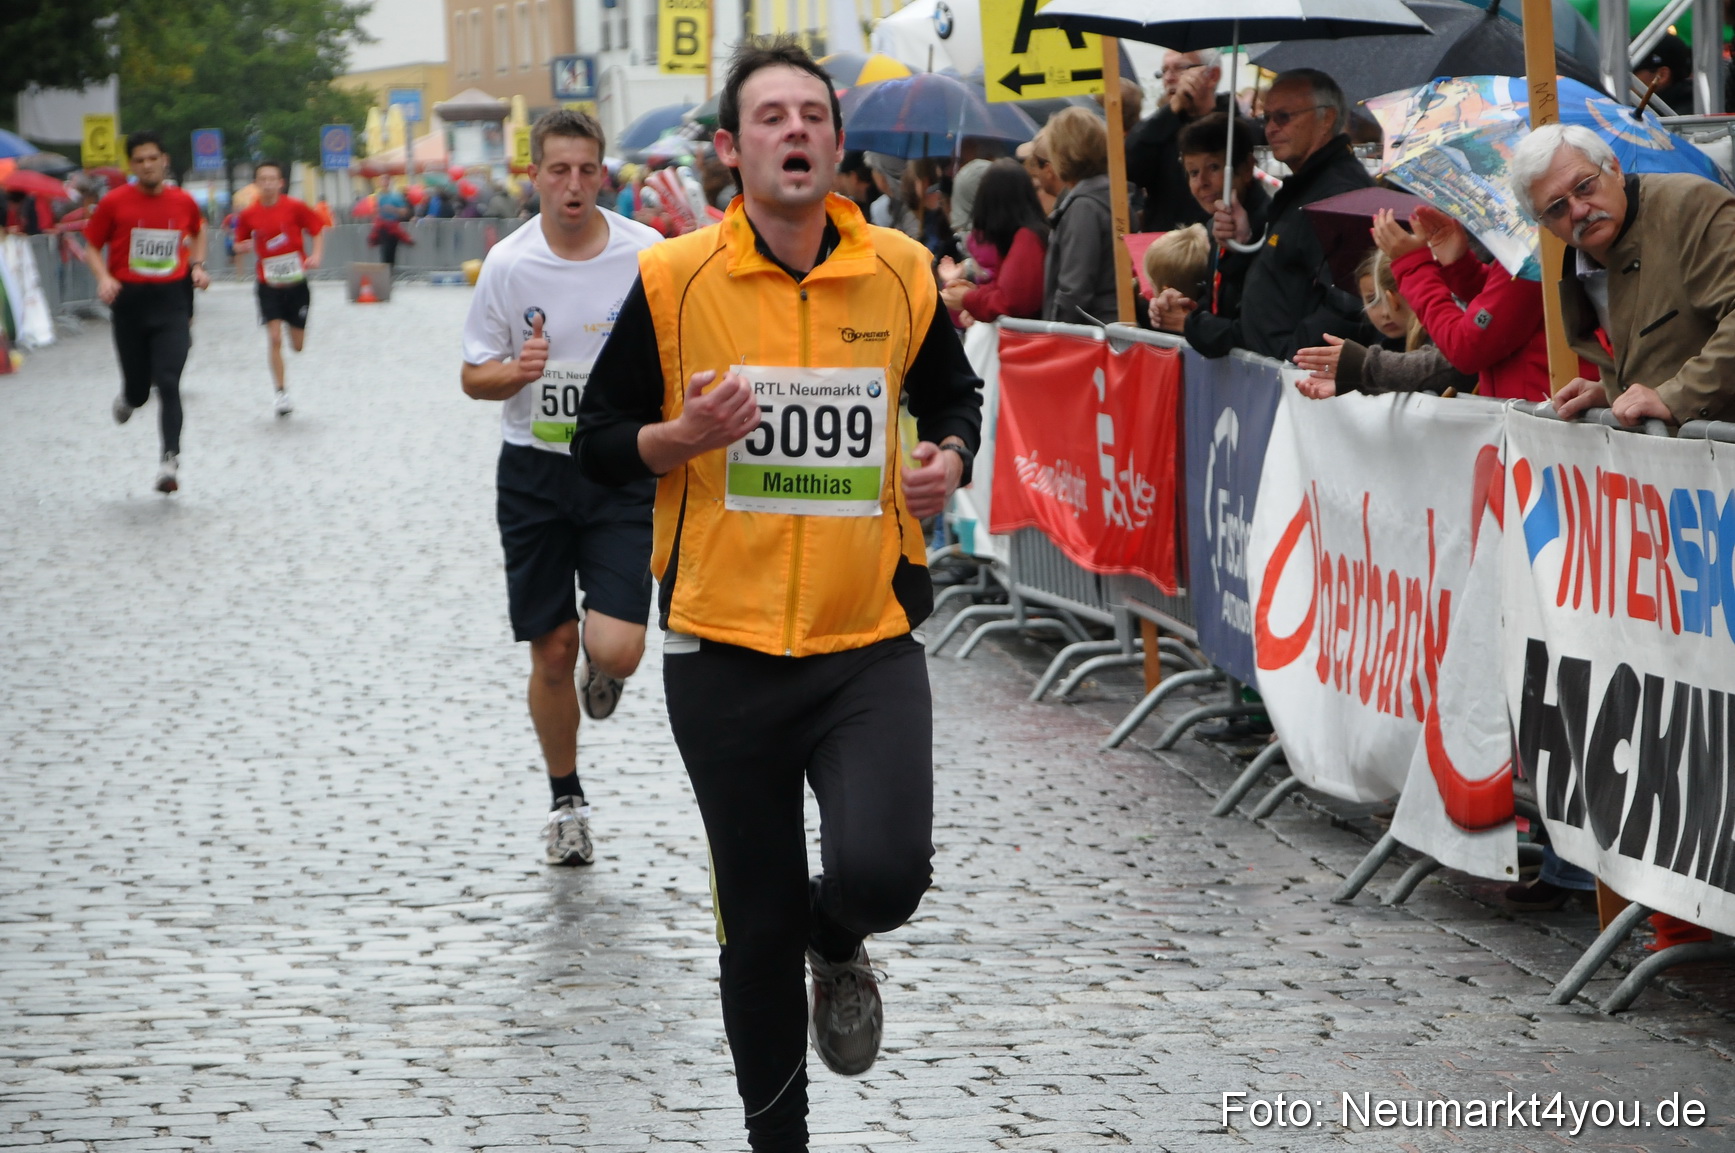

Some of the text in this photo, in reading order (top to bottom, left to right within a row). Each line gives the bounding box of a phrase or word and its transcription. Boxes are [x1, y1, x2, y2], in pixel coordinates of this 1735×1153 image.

[672, 16, 699, 56] B
[1010, 0, 1088, 54] A
[89, 126, 108, 151] C
[135, 239, 174, 256] 5060
[542, 369, 564, 379] RTL
[541, 383, 587, 418] 50
[790, 383, 861, 396] Neumarkt
[745, 404, 873, 459] 5099
[763, 472, 852, 495] Matthias
[1255, 479, 1452, 723] Oberbank
